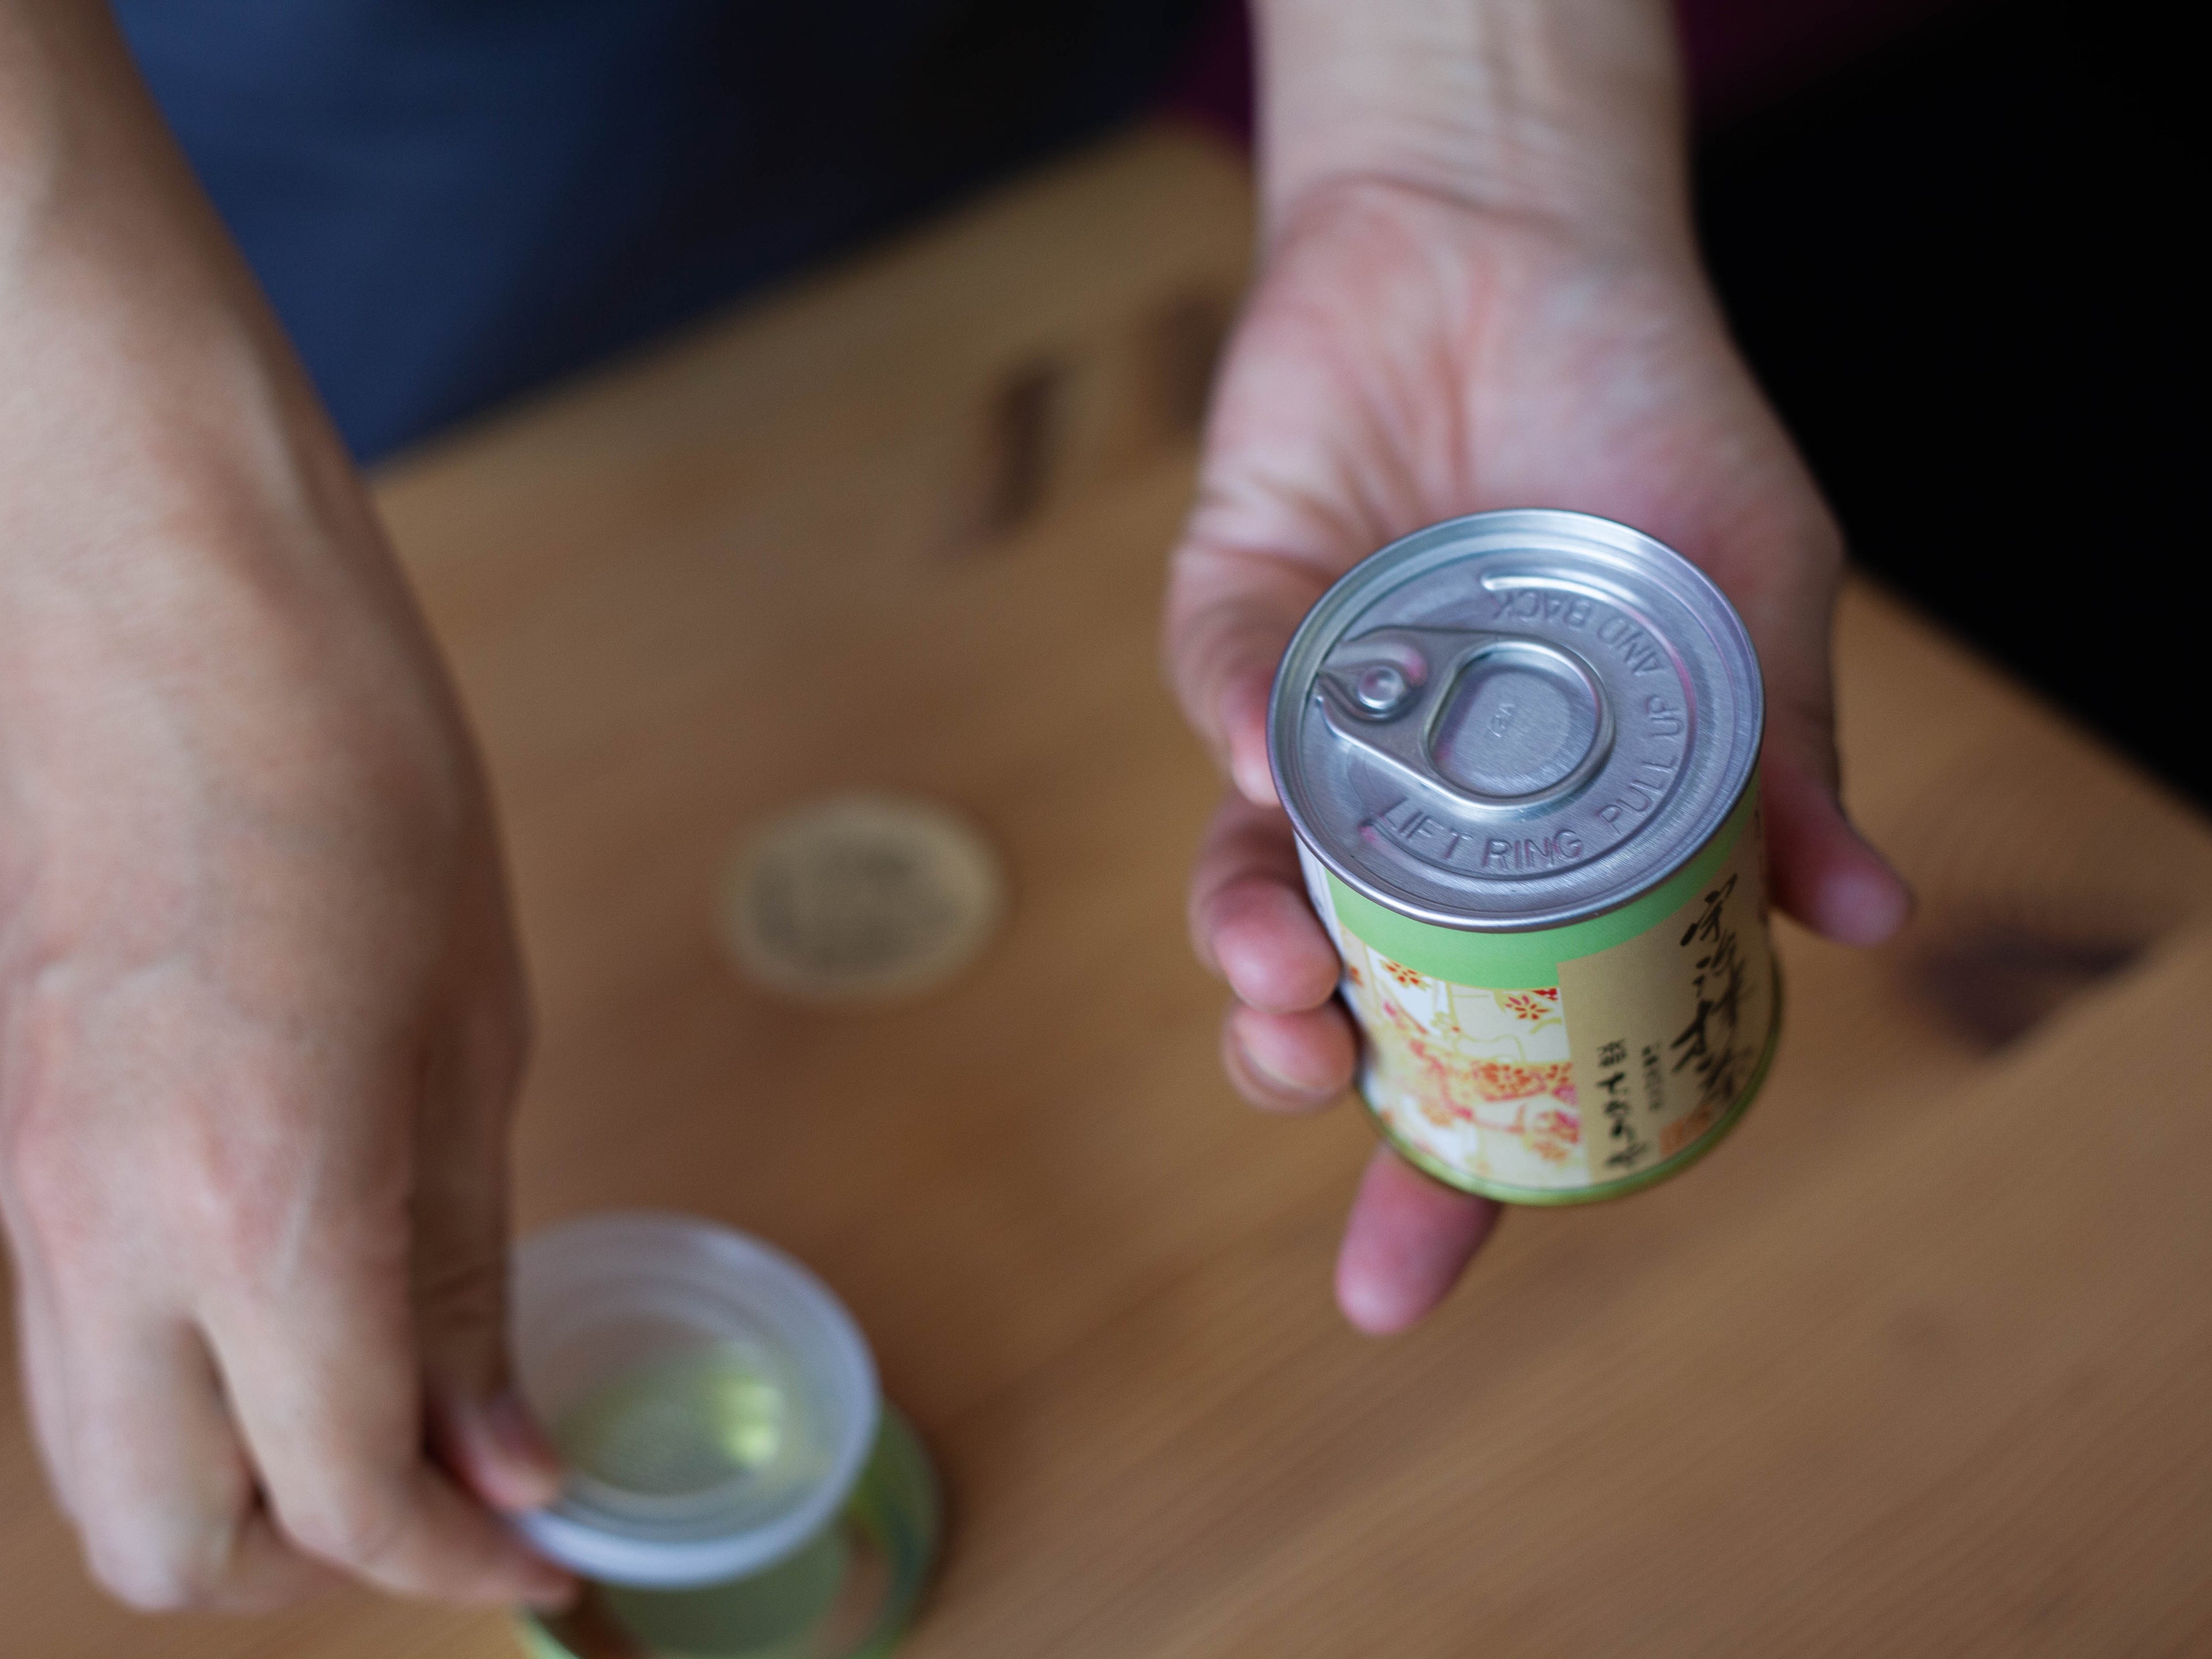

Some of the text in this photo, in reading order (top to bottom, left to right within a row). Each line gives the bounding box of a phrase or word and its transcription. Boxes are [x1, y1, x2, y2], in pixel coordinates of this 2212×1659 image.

[1380, 589, 1683, 871] LIFT RING PULL UP AND BACK
